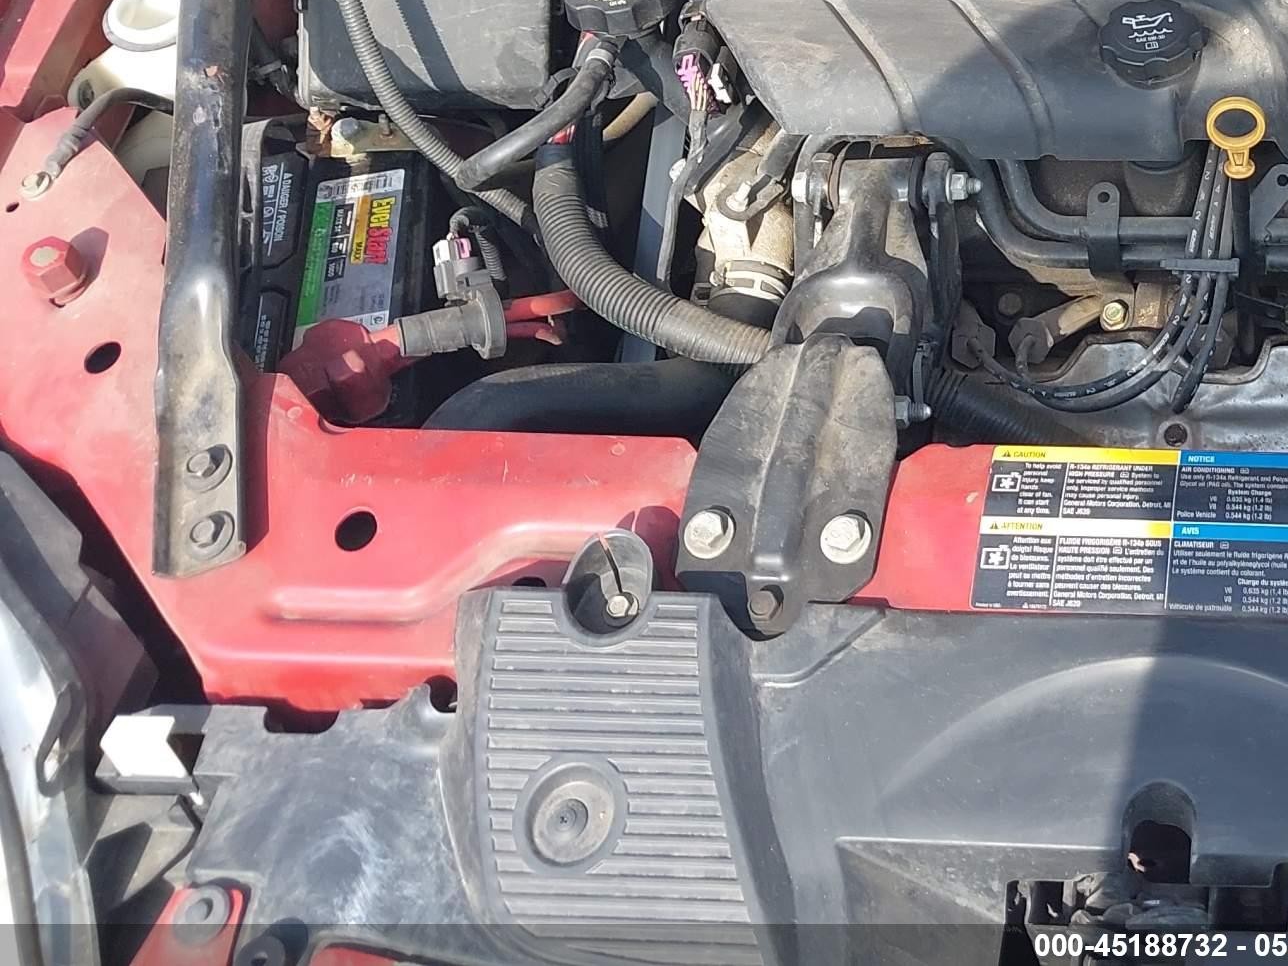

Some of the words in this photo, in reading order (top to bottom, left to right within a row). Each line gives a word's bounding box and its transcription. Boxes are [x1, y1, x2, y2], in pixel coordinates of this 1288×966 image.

[280, 179, 292, 208] DANGER
[274, 214, 287, 242] POISON
[365, 196, 396, 265] EverStart
[1188, 455, 1215, 463] NOTICE
[1182, 527, 1199, 535] AVIS
[1238, 578, 1259, 586] Charge
[1260, 606, 1267, 614] kg
